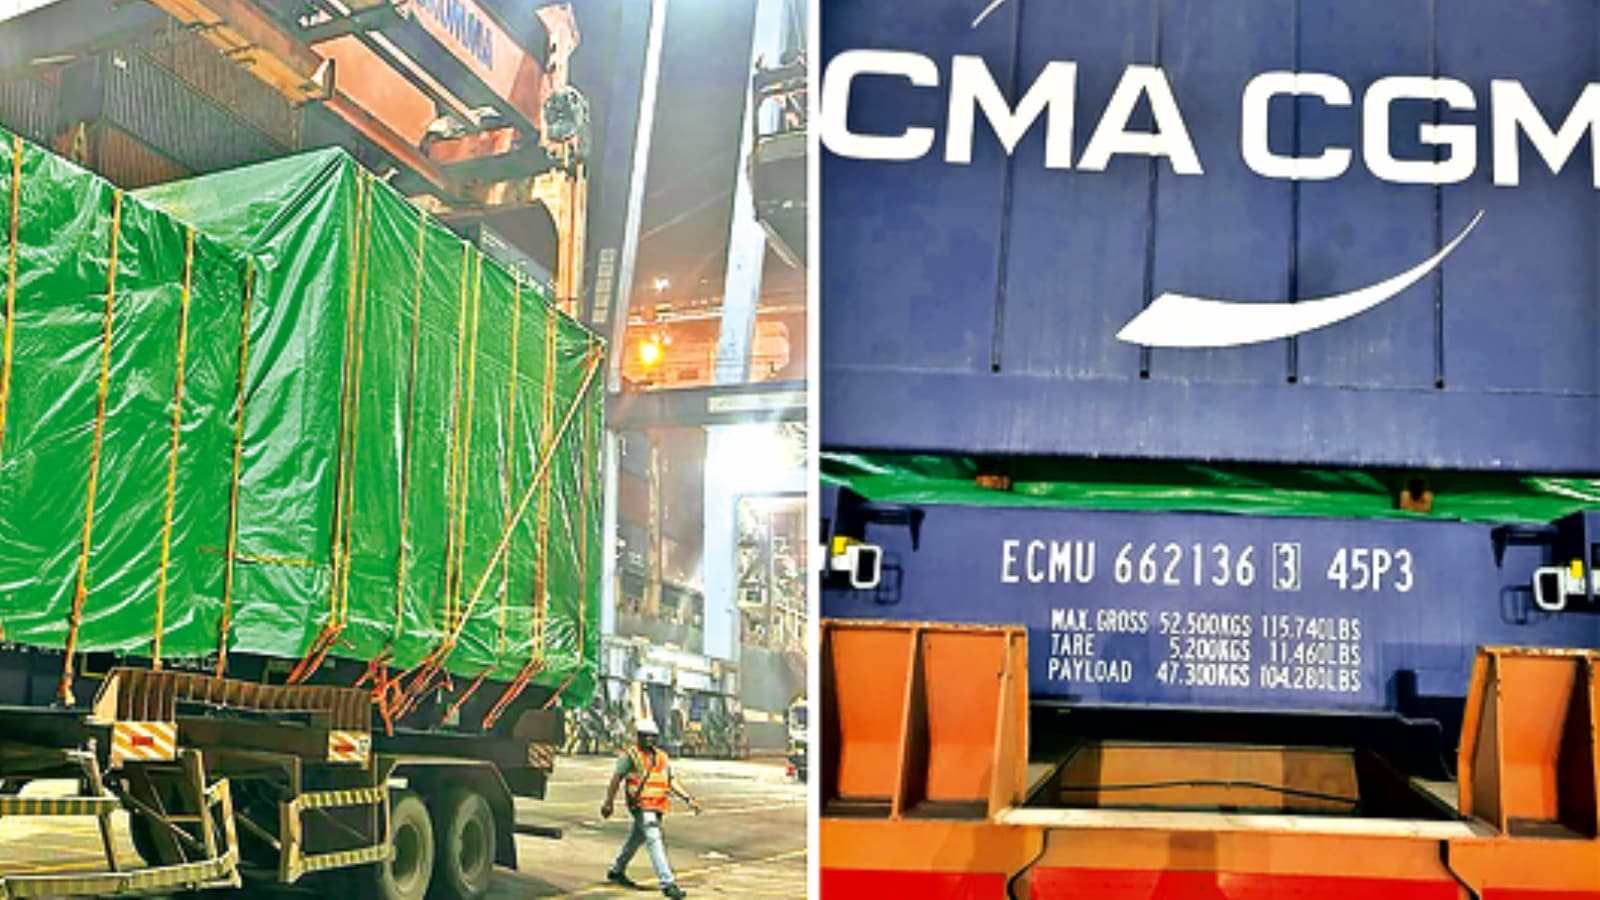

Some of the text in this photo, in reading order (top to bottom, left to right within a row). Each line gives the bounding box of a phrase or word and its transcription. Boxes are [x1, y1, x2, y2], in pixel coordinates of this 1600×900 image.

[820, 49, 1600, 188] CMA CGM
[1001, 540, 1414, 593] ECMU 662136 3 45P3
[1051, 608, 1093, 631] MAX.
[1097, 609, 1150, 634] GROSS
[1051, 633, 1095, 656] TARE
[1048, 657, 1132, 683] PAYLOAD
